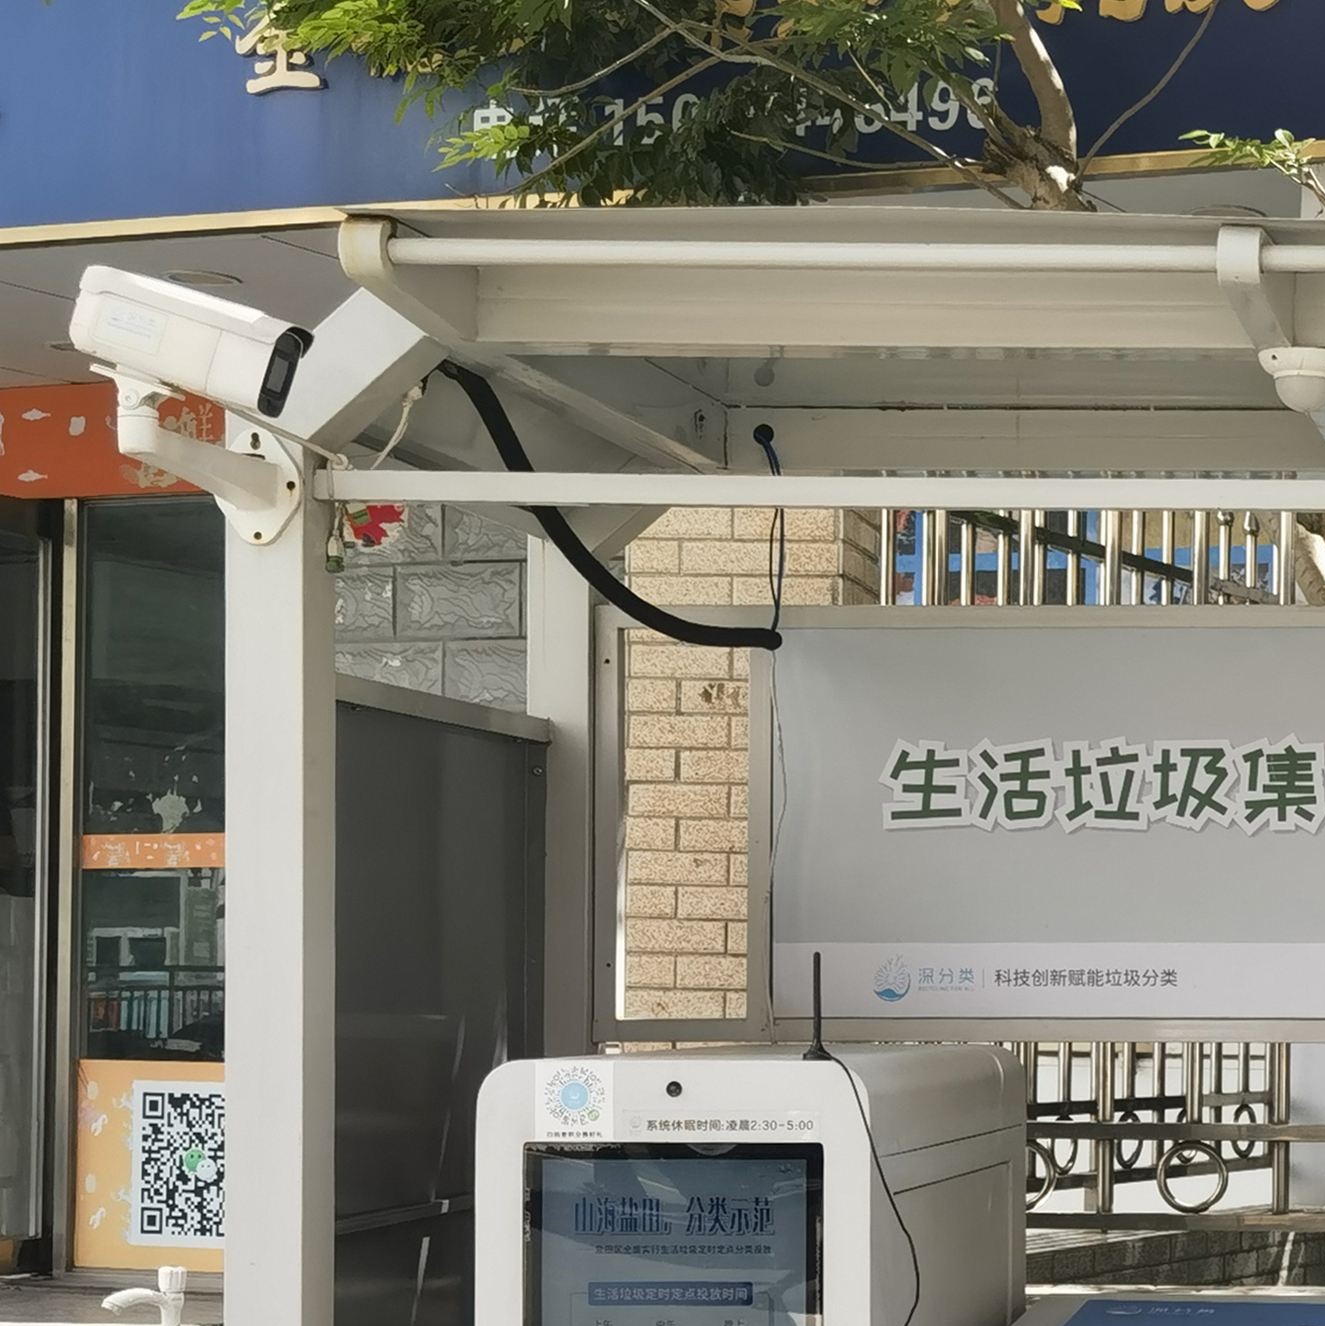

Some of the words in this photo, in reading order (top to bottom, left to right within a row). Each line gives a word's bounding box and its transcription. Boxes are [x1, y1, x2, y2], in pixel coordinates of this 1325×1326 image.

[918, 968, 974, 984] 深分类
[994, 969, 1177, 987] 科技创新赋能垃圾分类
